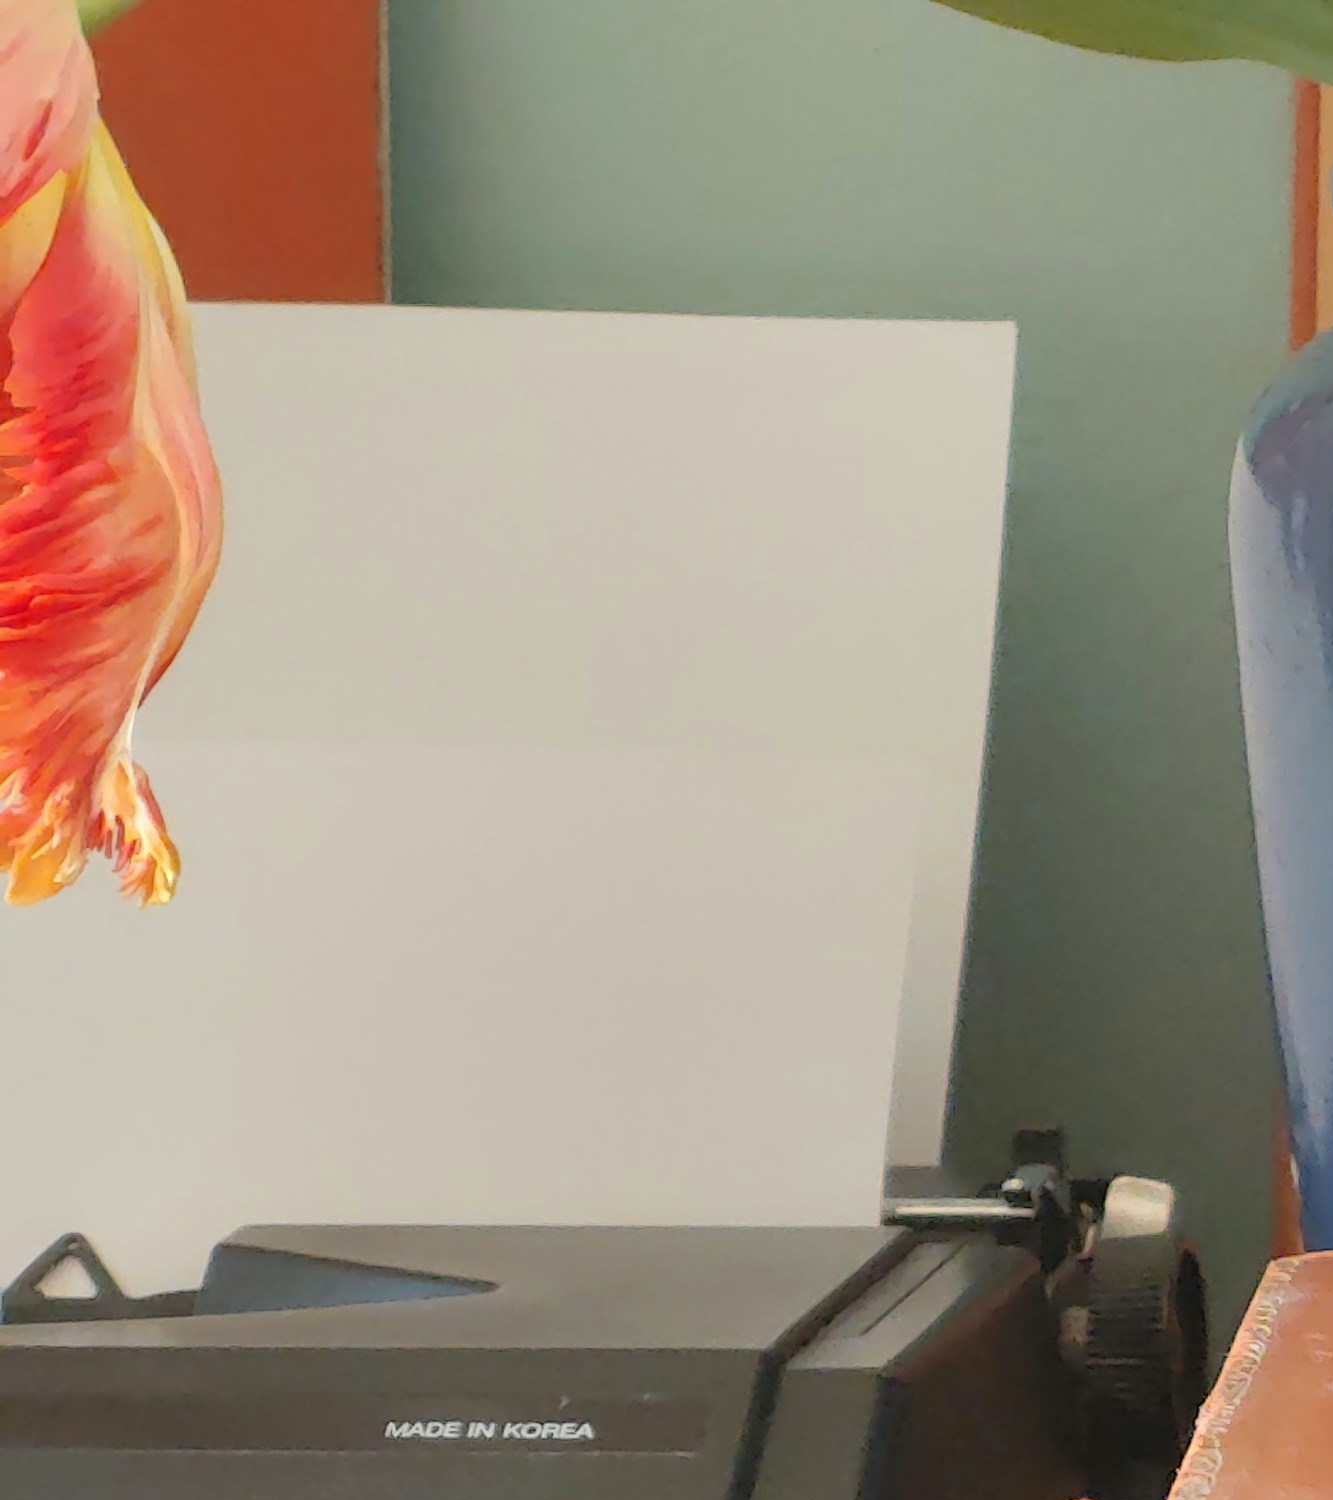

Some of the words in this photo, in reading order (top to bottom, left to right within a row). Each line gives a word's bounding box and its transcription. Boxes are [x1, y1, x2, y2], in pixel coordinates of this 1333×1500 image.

[384, 1420, 462, 1439] MADE
[467, 1420, 496, 1440] IN
[502, 1420, 595, 1441] KOREA
